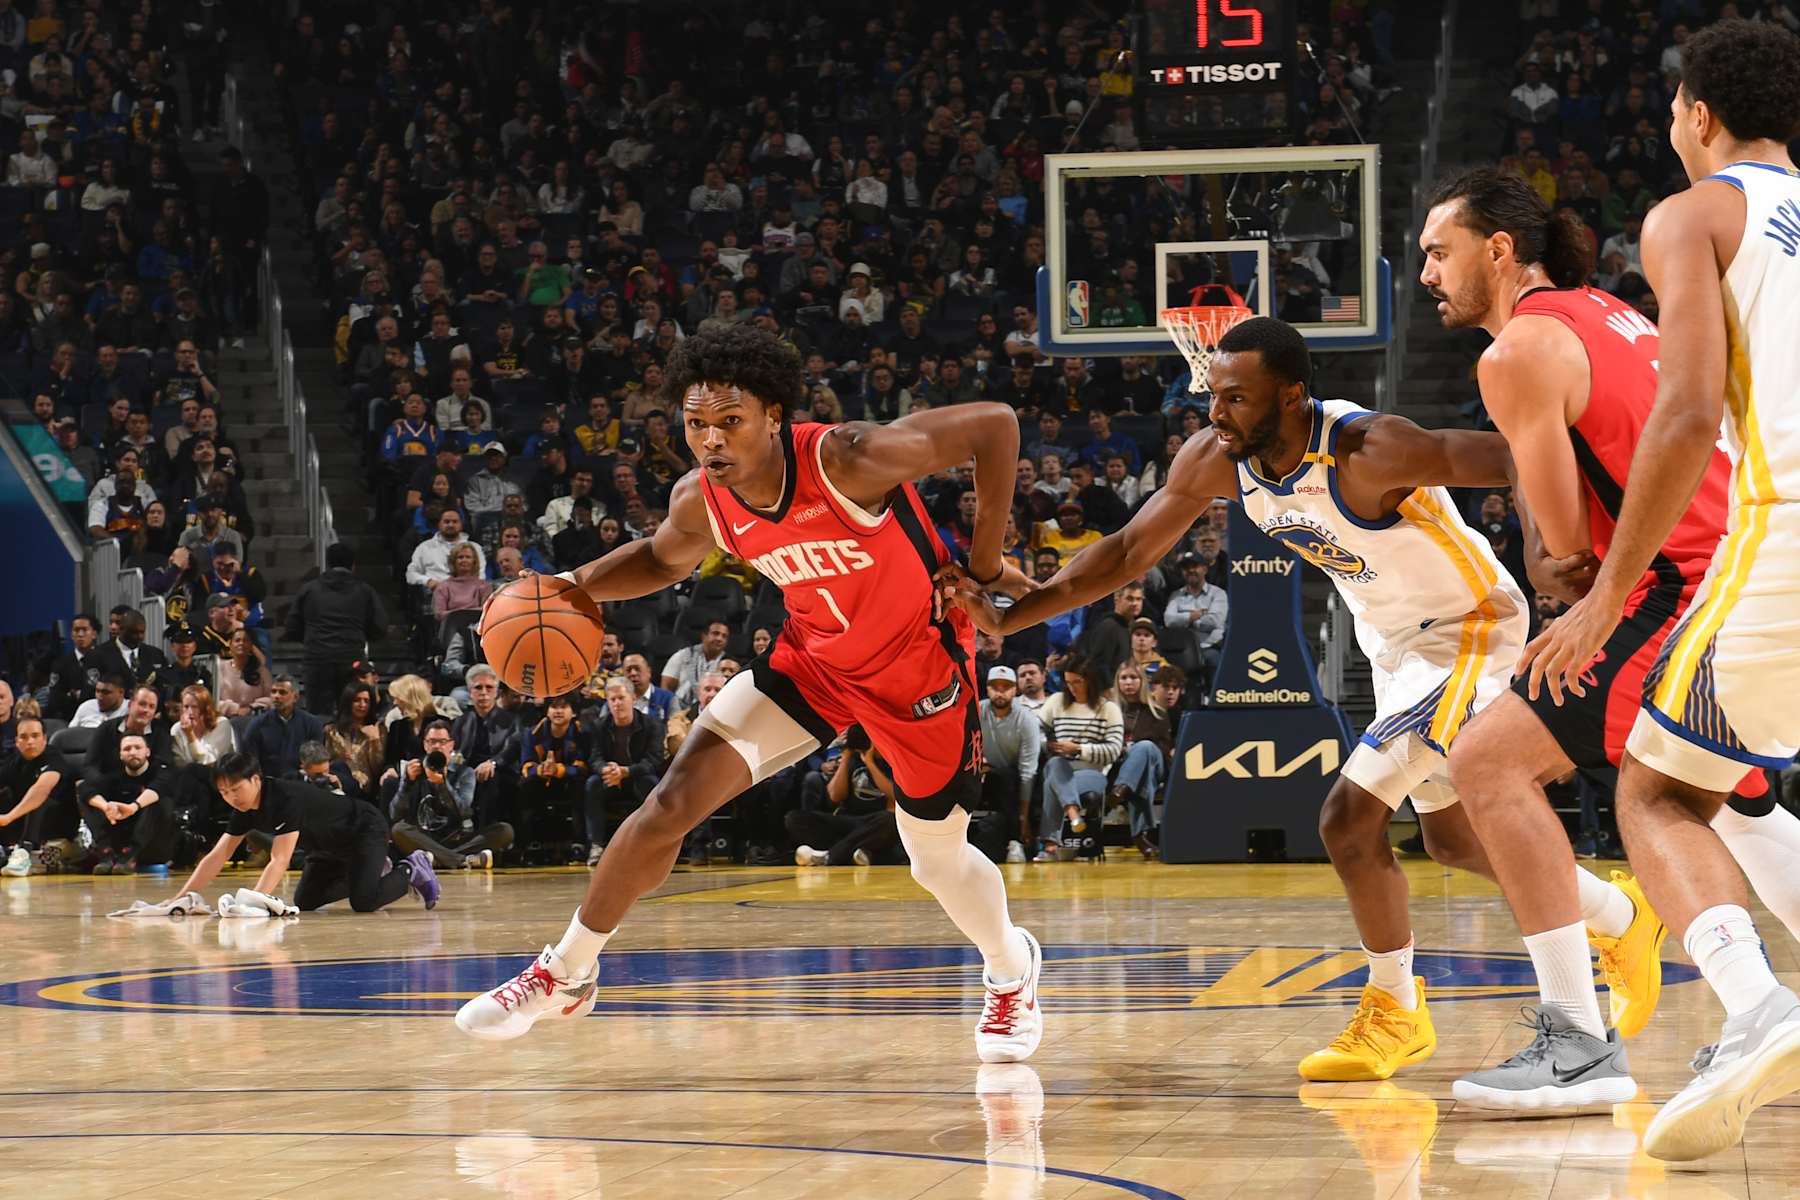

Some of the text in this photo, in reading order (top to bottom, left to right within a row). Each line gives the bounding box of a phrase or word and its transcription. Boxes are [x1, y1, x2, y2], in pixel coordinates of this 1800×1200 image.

[1197, 0, 1262, 47] 15
[1186, 62, 1281, 83] TISSOT
[1258, 515, 1338, 543] OLDEN STATE
[1231, 555, 1294, 576] xfinity
[816, 588, 850, 631] 1
[1216, 689, 1310, 703] SentinelOne
